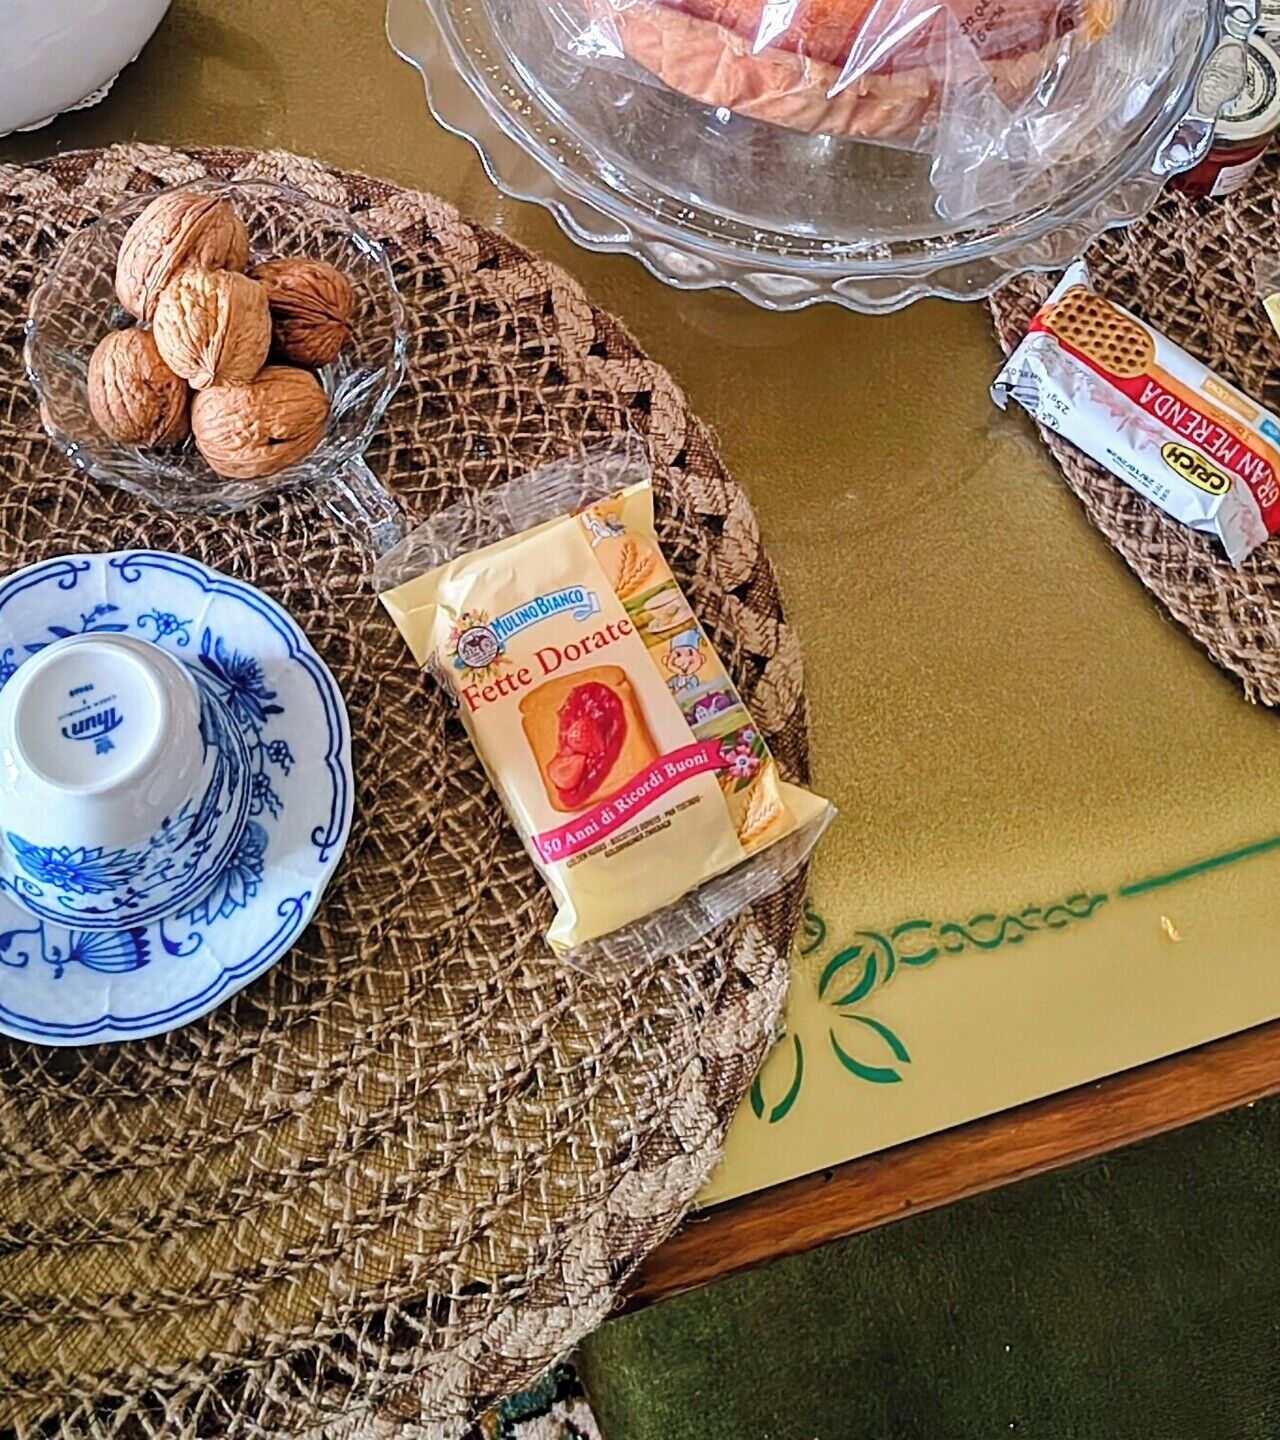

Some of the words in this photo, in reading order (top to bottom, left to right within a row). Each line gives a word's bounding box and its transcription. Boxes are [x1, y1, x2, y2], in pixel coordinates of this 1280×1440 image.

[1139, 381, 1241, 463] MERENDA
[1166, 446, 1226, 491] CRICH
[1234, 451, 1280, 509] GRAN
[489, 606, 539, 640] MULINO
[534, 589, 584, 616] BIANCO
[462, 667, 533, 712] Fette
[533, 618, 633, 676] Dorate
[61, 707, 123, 740] Thun
[542, 840, 563, 856] 50
[565, 818, 600, 846] Anni
[601, 806, 617, 826] di
[613, 769, 665, 814] Ricordi
[663, 748, 709, 779] Buoni
